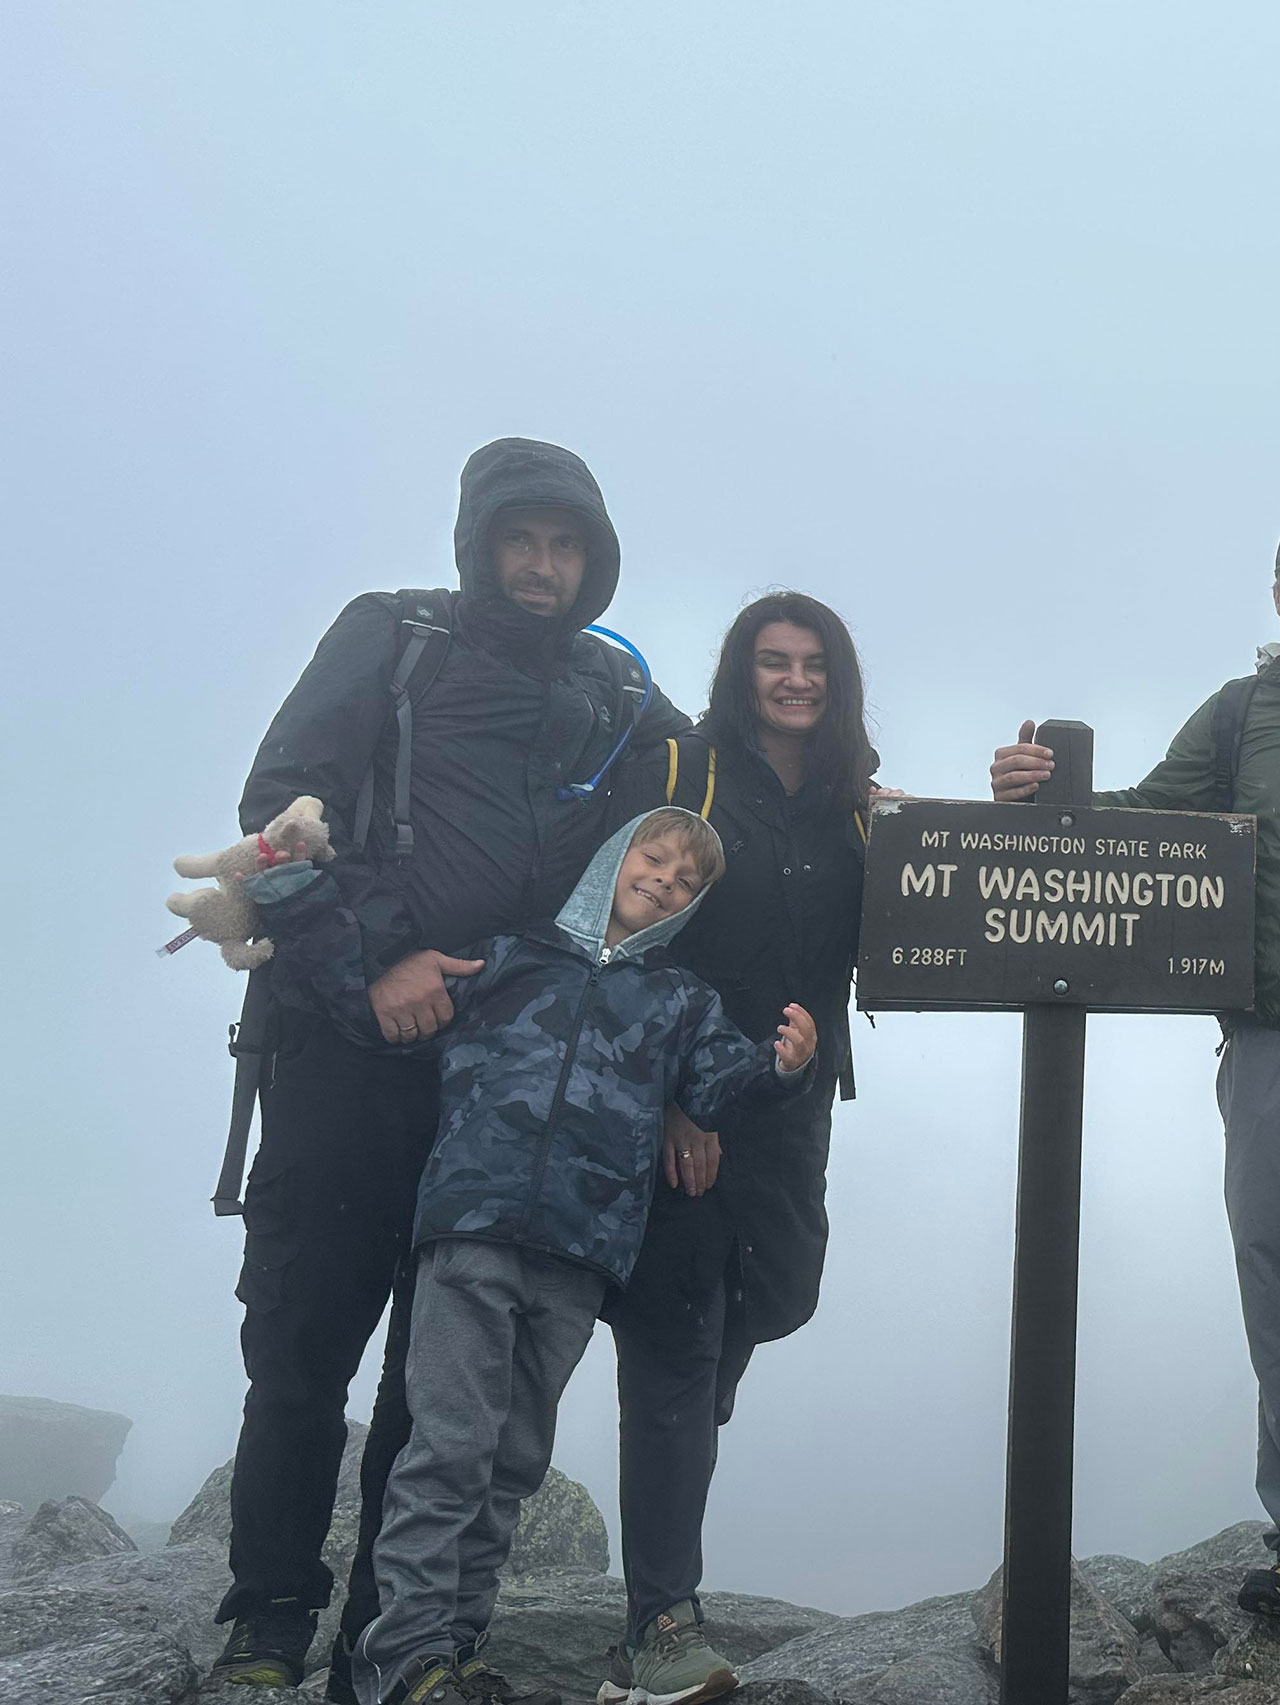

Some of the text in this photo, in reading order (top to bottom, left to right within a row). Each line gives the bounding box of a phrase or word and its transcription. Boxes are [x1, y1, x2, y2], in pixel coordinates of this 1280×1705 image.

[921, 830, 1208, 860] MT WASHINGTON STATE PARK
[900, 862, 1225, 909] MT WASHINGTON
[984, 907, 1141, 947] SUMMIT
[892, 946, 968, 966] 6.288FT
[1167, 957, 1225, 976] 1.917M
